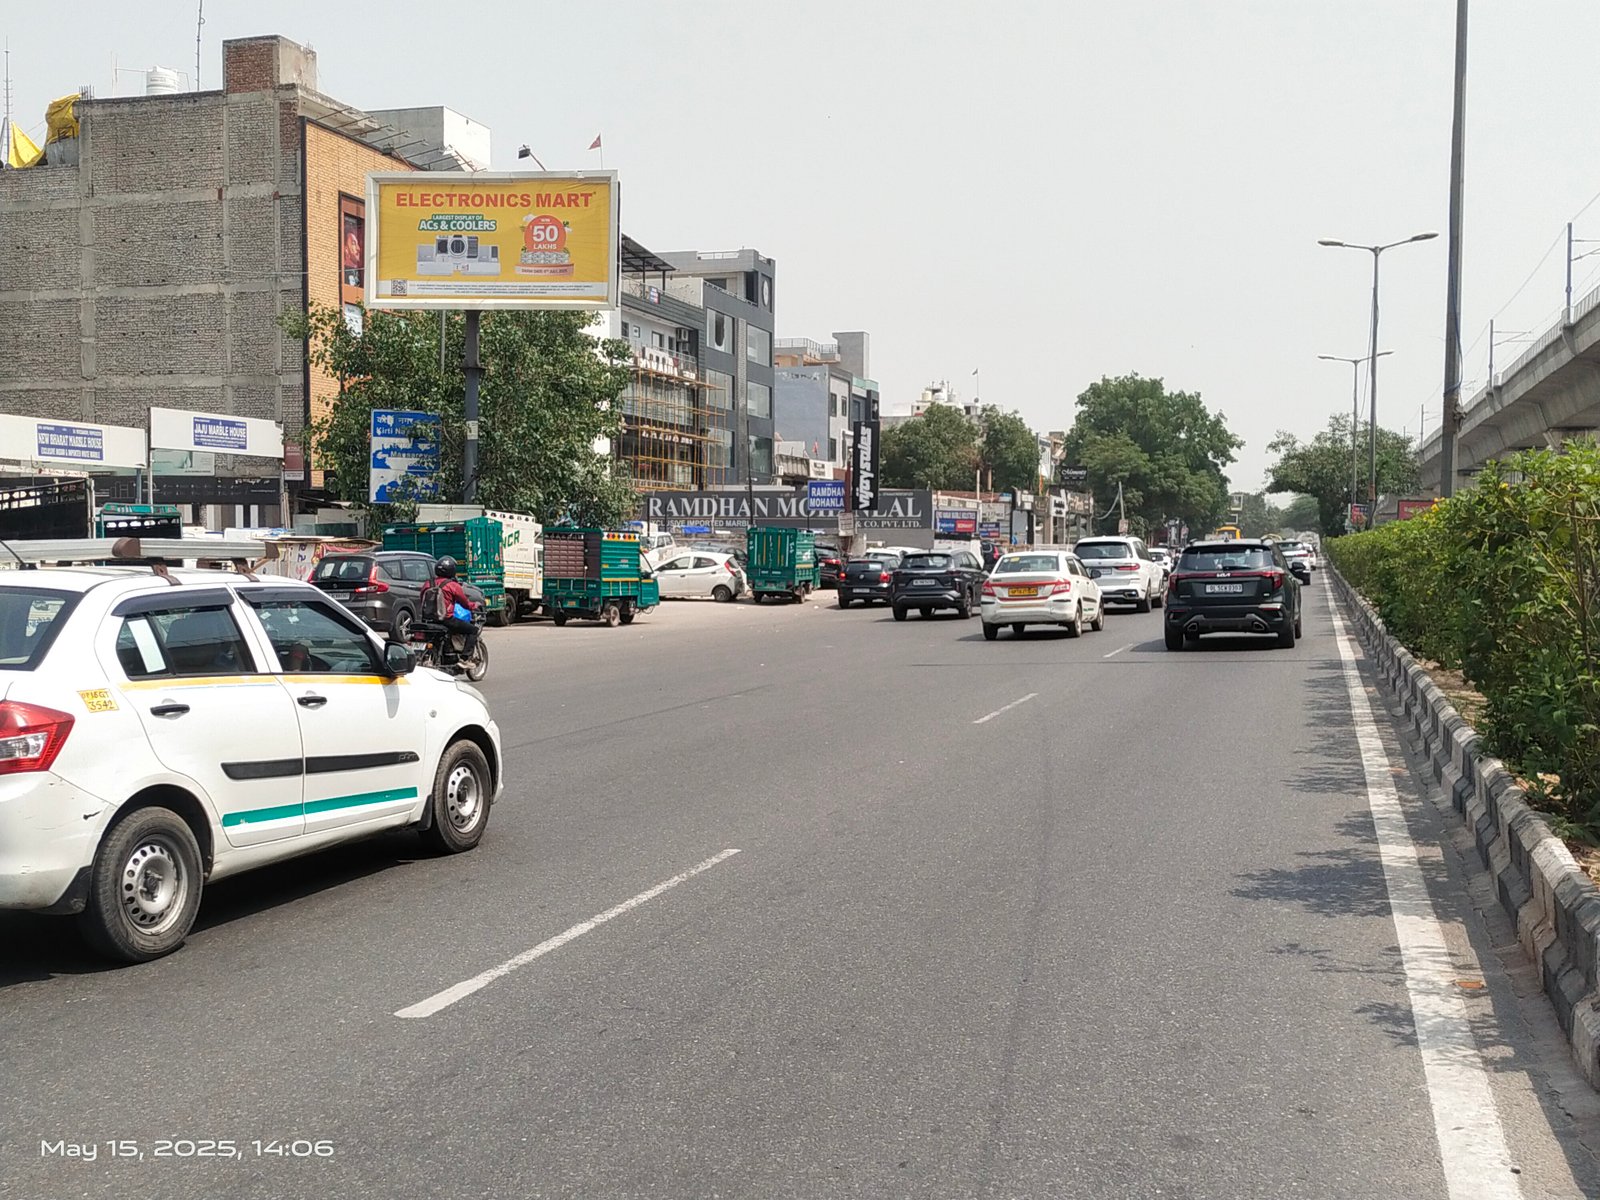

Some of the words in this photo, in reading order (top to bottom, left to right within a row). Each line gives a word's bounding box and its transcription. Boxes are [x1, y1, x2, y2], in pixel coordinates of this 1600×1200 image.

[396, 192, 531, 208] ELECTRONICS
[536, 192, 593, 208] MART
[419, 220, 439, 230] ACs
[440, 220, 448, 230] &
[450, 220, 496, 231] COOLERS
[195, 423, 208, 435] JAJU
[208, 424, 229, 437] MARBLE
[229, 426, 246, 438] HOUSE
[38, 432, 49, 444] NEW
[50, 433, 68, 446] BHARAT
[69, 435, 87, 447] MARBLE
[88, 437, 102, 449] HOUSE
[649, 497, 769, 517] RAMDHAN
[809, 498, 844, 508] MOHANLA
[864, 520, 880, 528] CO.
[881, 520, 901, 528] PVT.
[902, 520, 922, 528] LTD.
[88, 700, 115, 711] 3542
